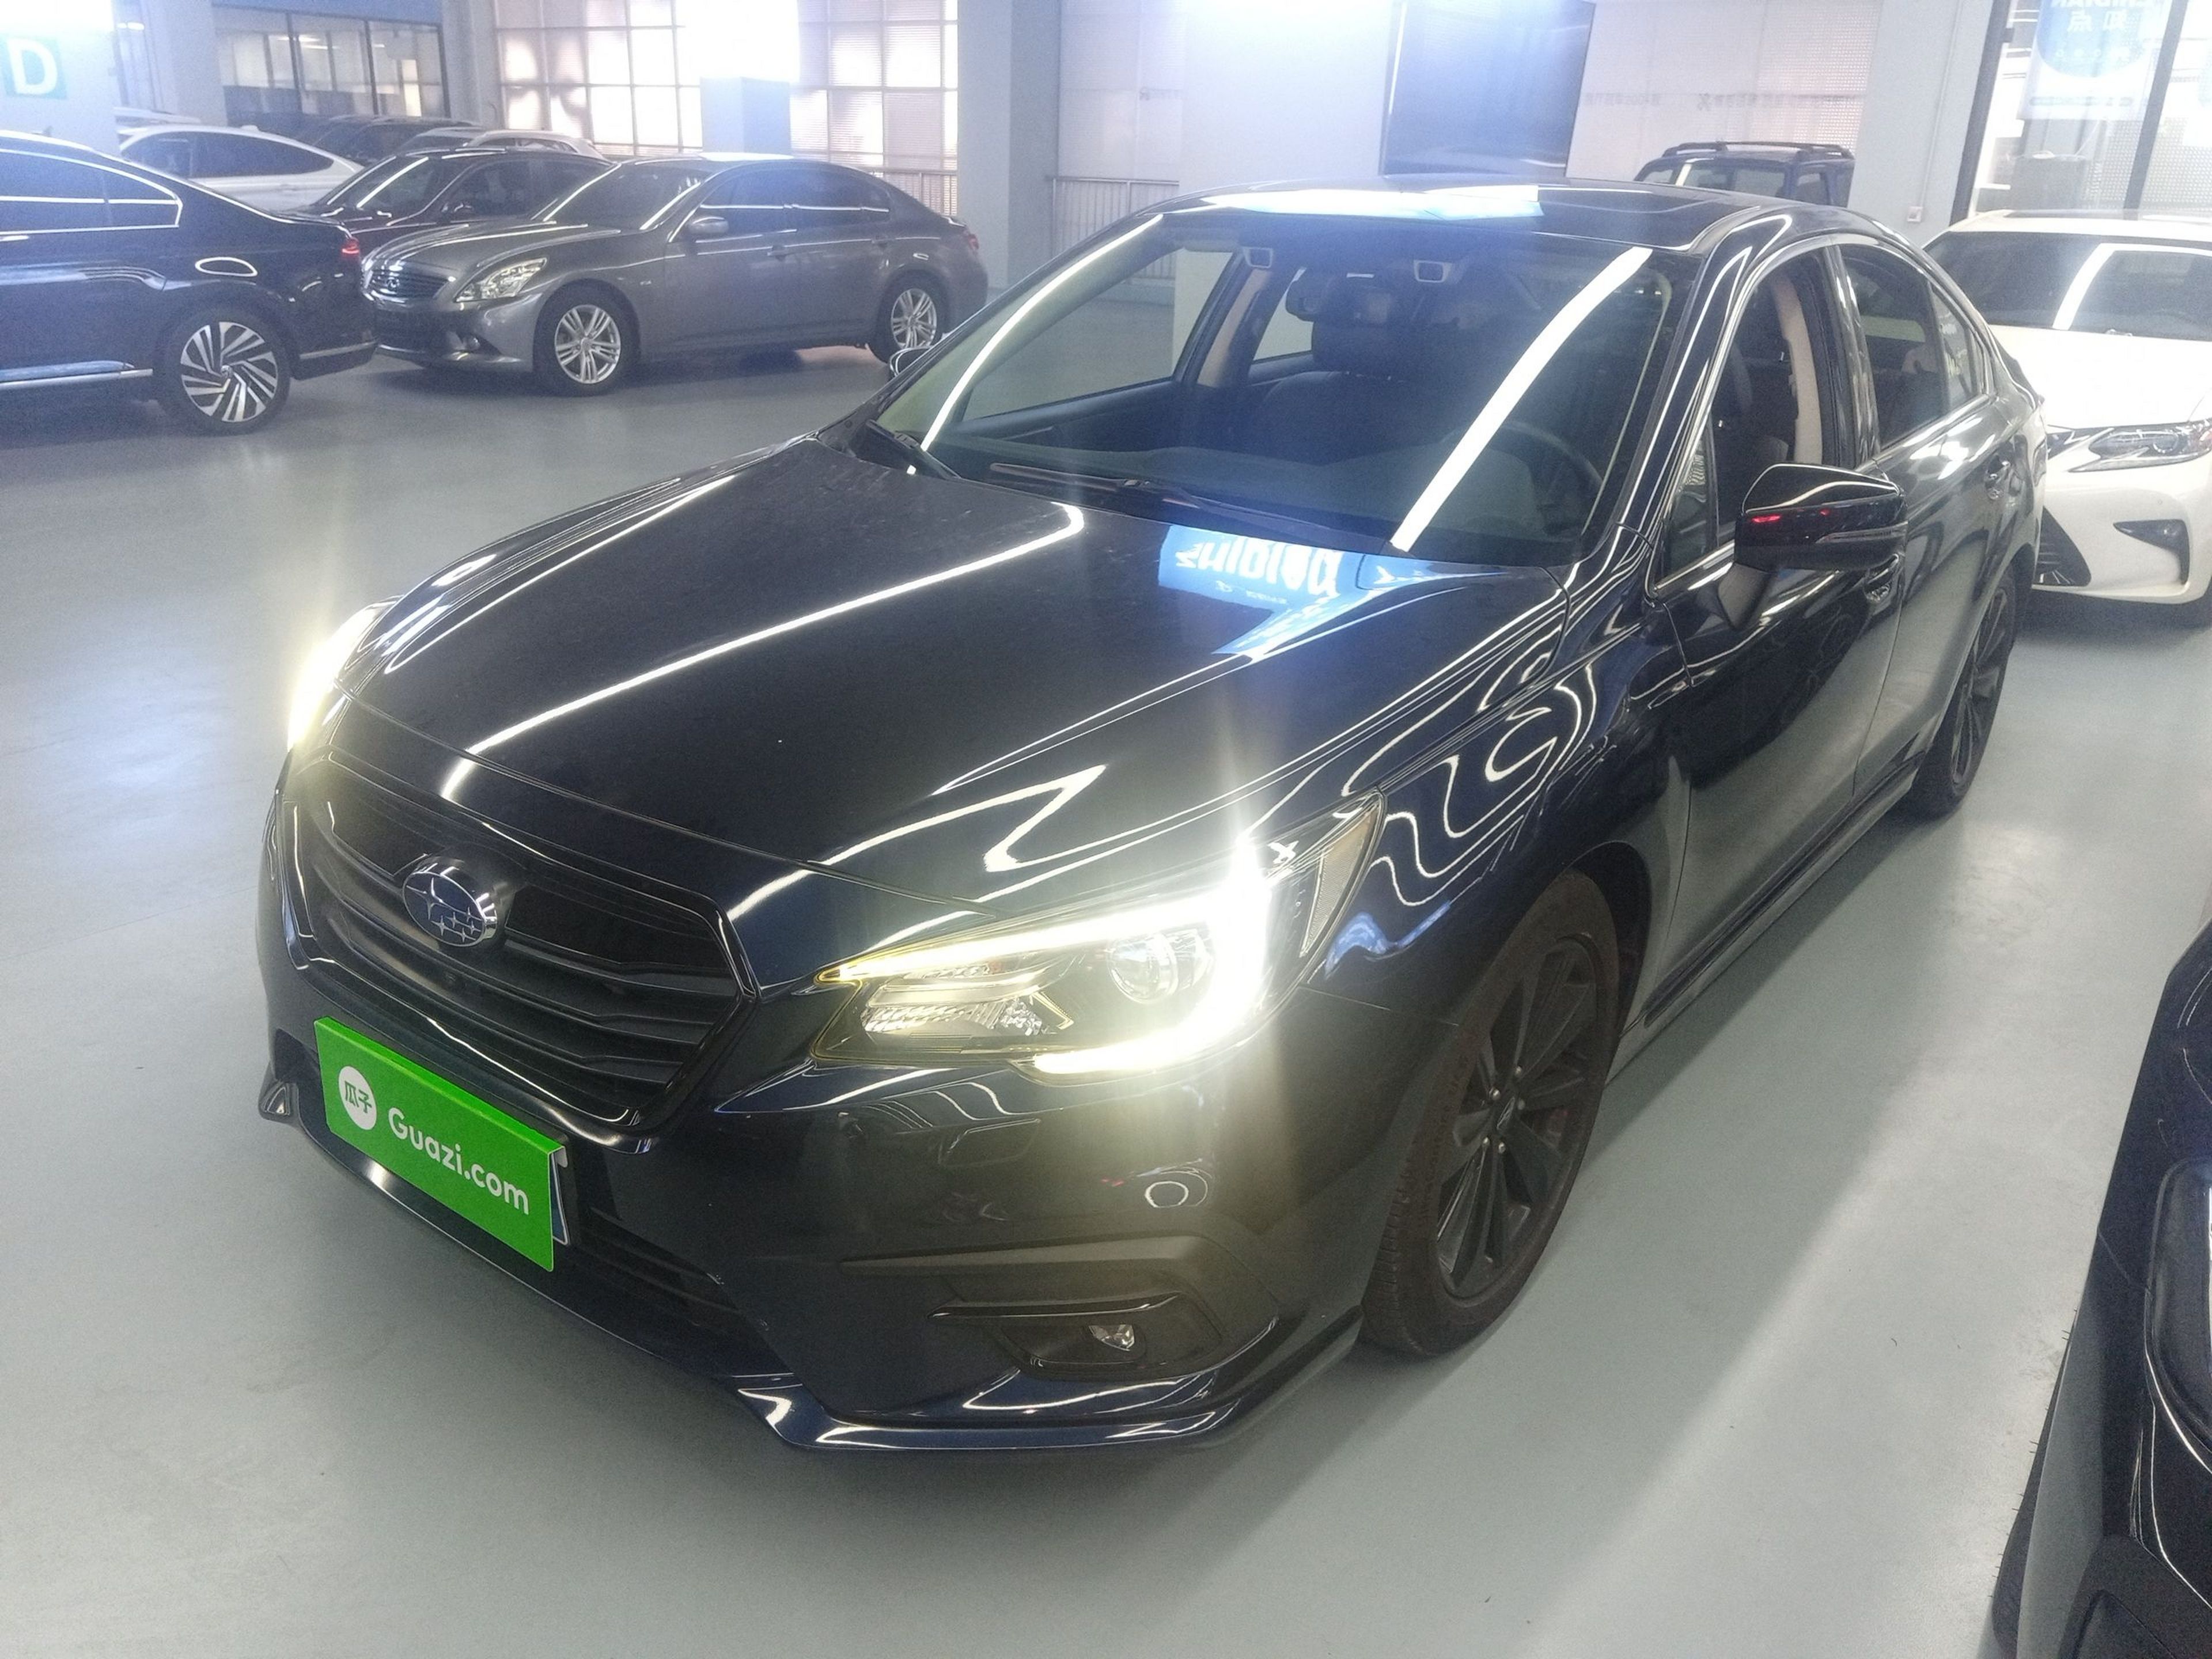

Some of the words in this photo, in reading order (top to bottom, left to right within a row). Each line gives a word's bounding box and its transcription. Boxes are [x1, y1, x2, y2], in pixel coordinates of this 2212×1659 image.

[7, 38, 58, 95] D
[344, 1080, 372, 1114] 瓜子
[388, 1107, 529, 1215] Guazi.com
